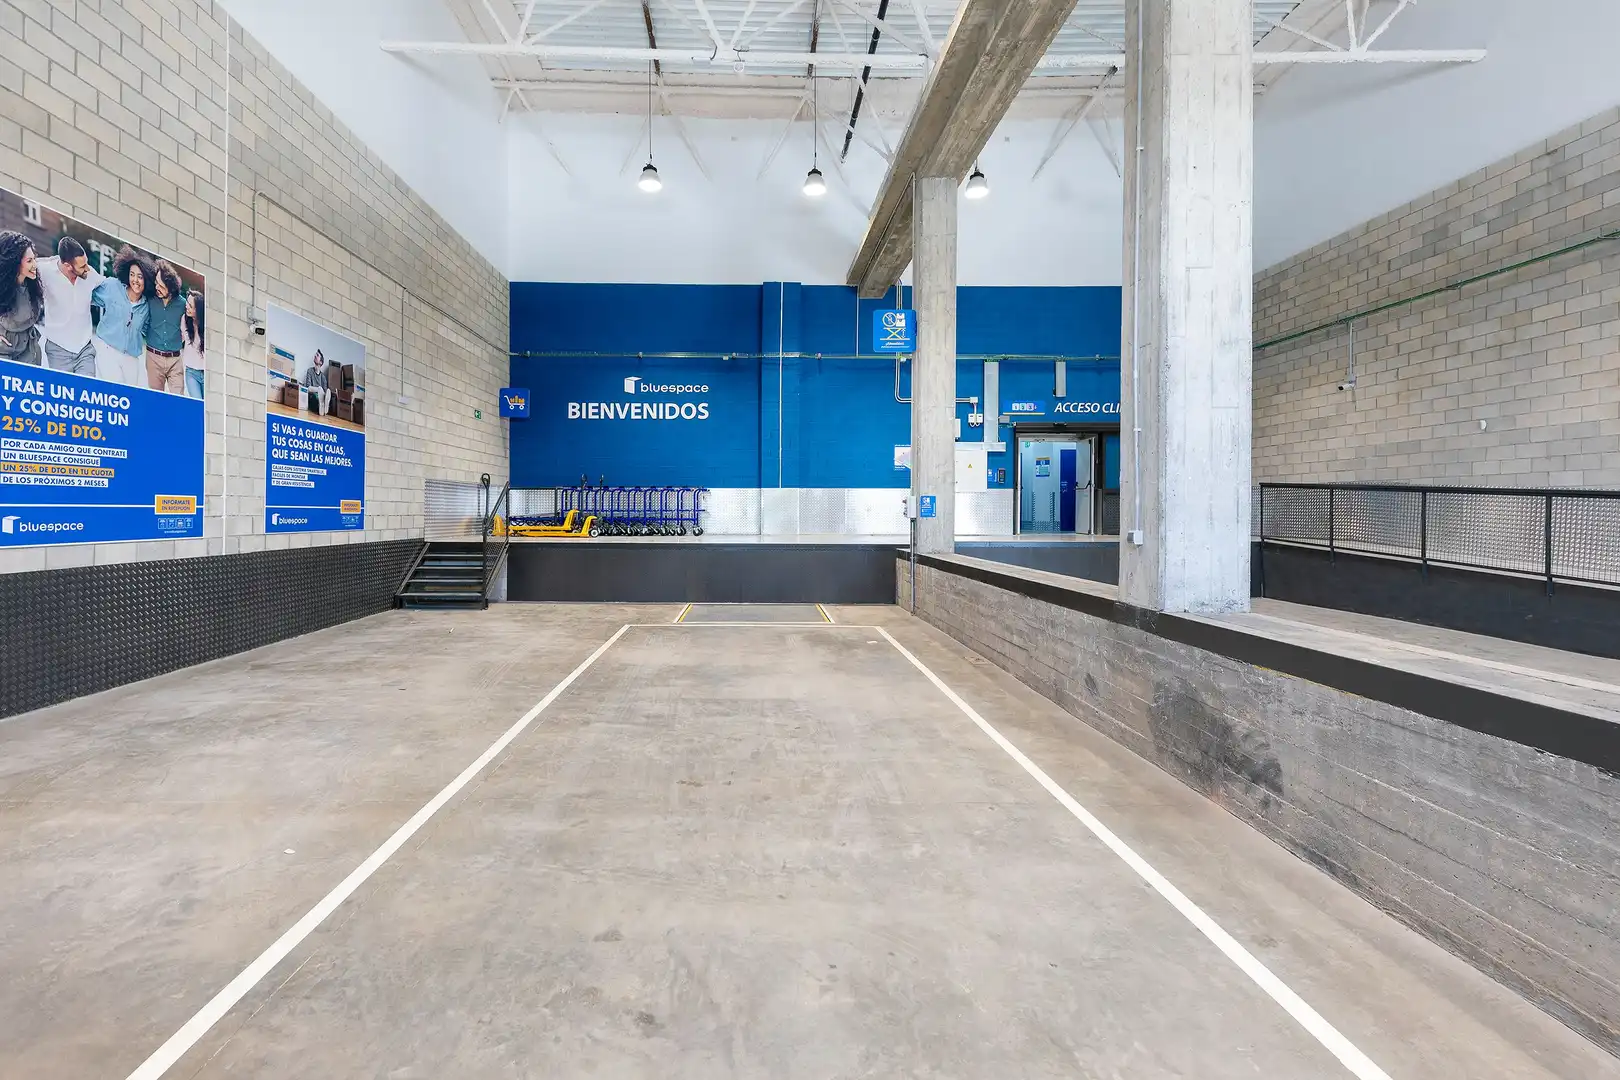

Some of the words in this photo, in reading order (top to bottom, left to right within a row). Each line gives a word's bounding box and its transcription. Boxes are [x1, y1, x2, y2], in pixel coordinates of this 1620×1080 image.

[2, 375, 44, 396] TRAE
[50, 384, 74, 401] UN
[80, 390, 130, 410] AMIGO
[640, 382, 709, 394] bluespace
[2, 396, 14, 410] Y
[20, 398, 102, 422] CONSIGUE
[108, 412, 128, 426] UN
[568, 402, 710, 420] BIENVENIDOS
[1054, 402, 1100, 413] ACCESO
[1102, 403, 1121, 413] CLI
[2, 416, 41, 433] 25%
[47, 421, 66, 436] DE
[72, 425, 106, 441] DTO.
[272, 423, 279, 432] SI
[281, 424, 296, 436] VAS
[298, 428, 304, 437] A
[306, 429, 337, 443] GUARDAR
[93, 449, 126, 458] CONTRATE
[272, 435, 286, 446] TUS
[288, 438, 312, 450] COSAS
[314, 442, 323, 452] EN
[325, 444, 345, 456] CAJAS,
[19, 454, 60, 462] BLUESPACE
[63, 457, 99, 465] CONSIGUE
[272, 448, 288, 459] QUE
[290, 451, 310, 462] SEAN
[312, 454, 323, 463] LAS
[325, 456, 352, 467] MEJORES.
[34, 476, 75, 486] PRÓXIMOS
[20, 522, 84, 533] bluespace
